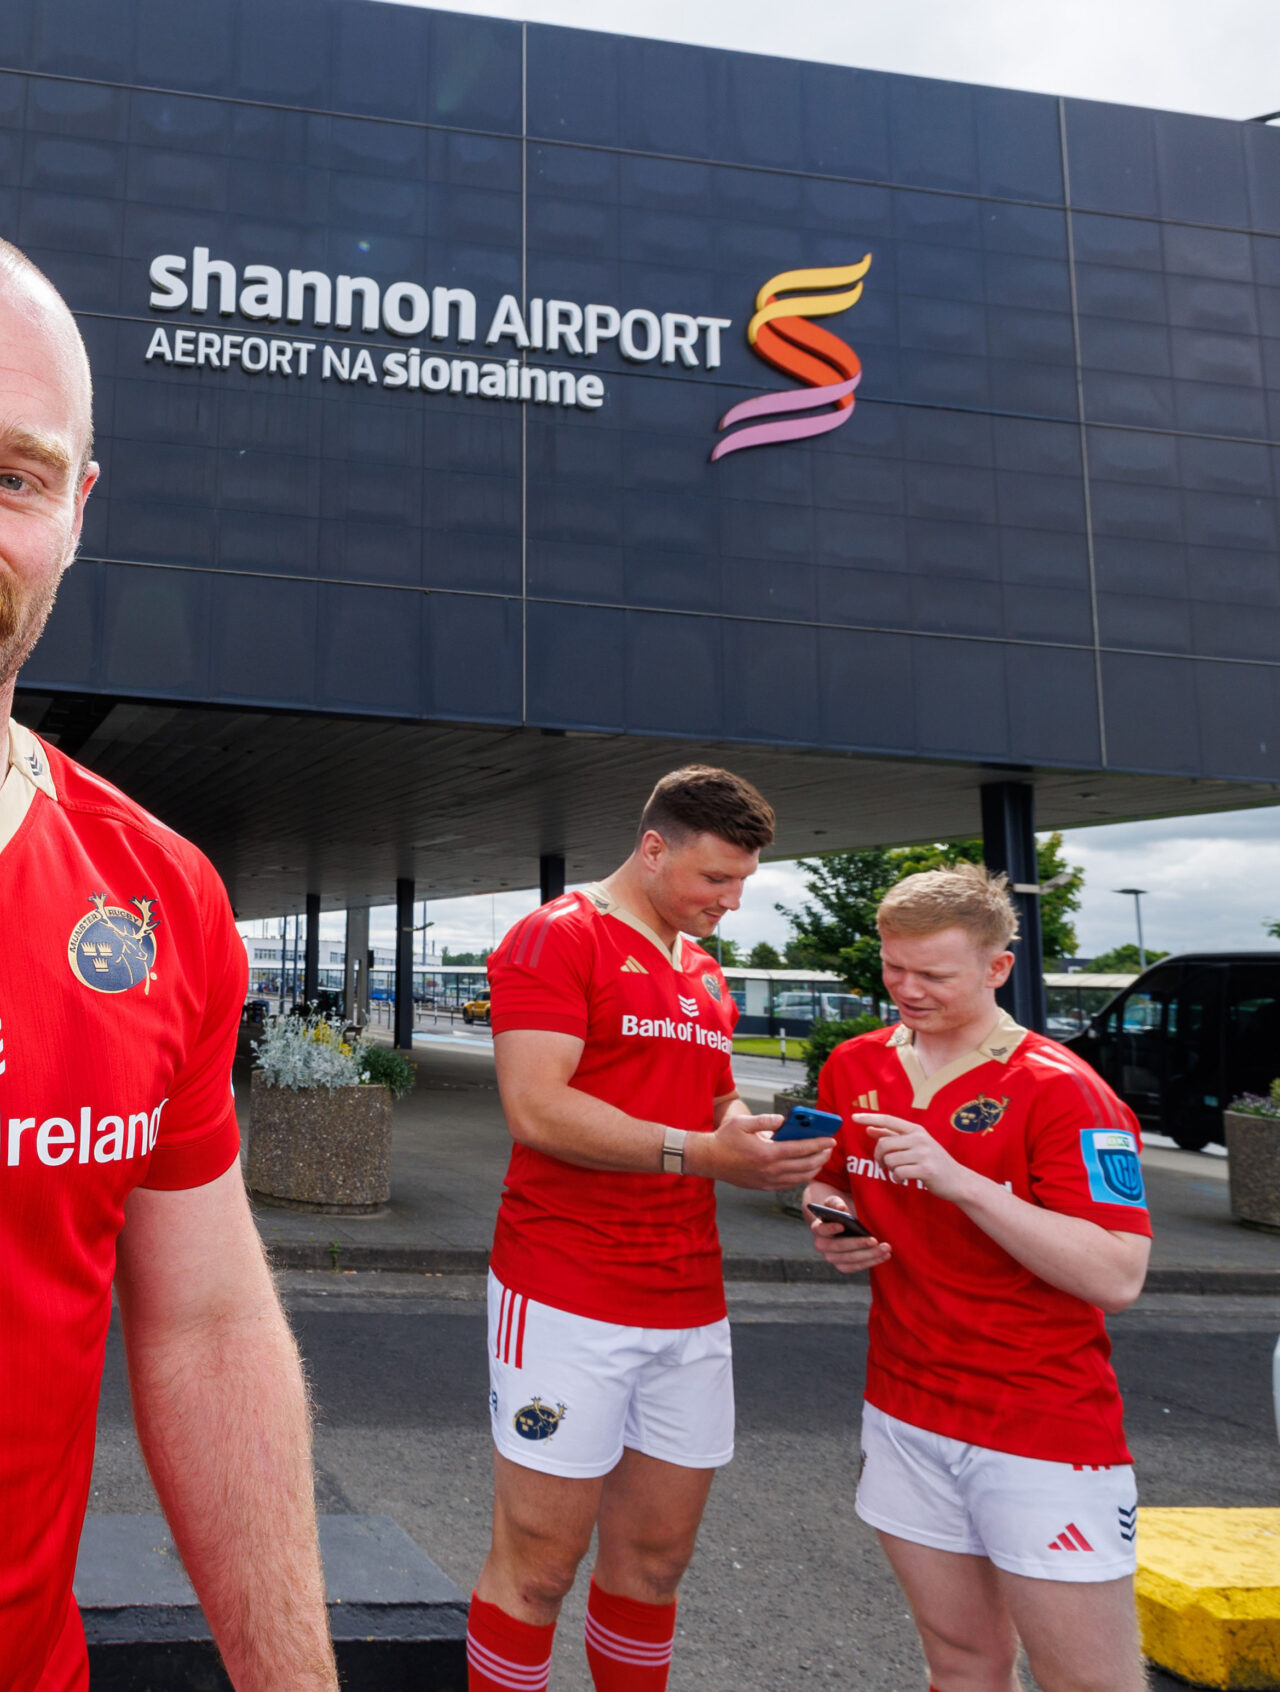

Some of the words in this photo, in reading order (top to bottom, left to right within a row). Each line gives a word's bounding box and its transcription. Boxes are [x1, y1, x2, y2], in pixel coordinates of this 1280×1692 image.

[149, 246, 477, 343] shannon
[485, 294, 732, 370] AIRPORT
[145, 327, 317, 377] AERFORT
[322, 344, 378, 383] NA
[382, 347, 605, 410] sionainne
[69, 912, 99, 954] MUNSTER
[107, 908, 139, 924] RUGBY
[621, 1014, 676, 1039] Bank
[677, 1022, 694, 1042] of
[695, 1024, 733, 1056] Irela
[846, 1154, 887, 1182] ank
